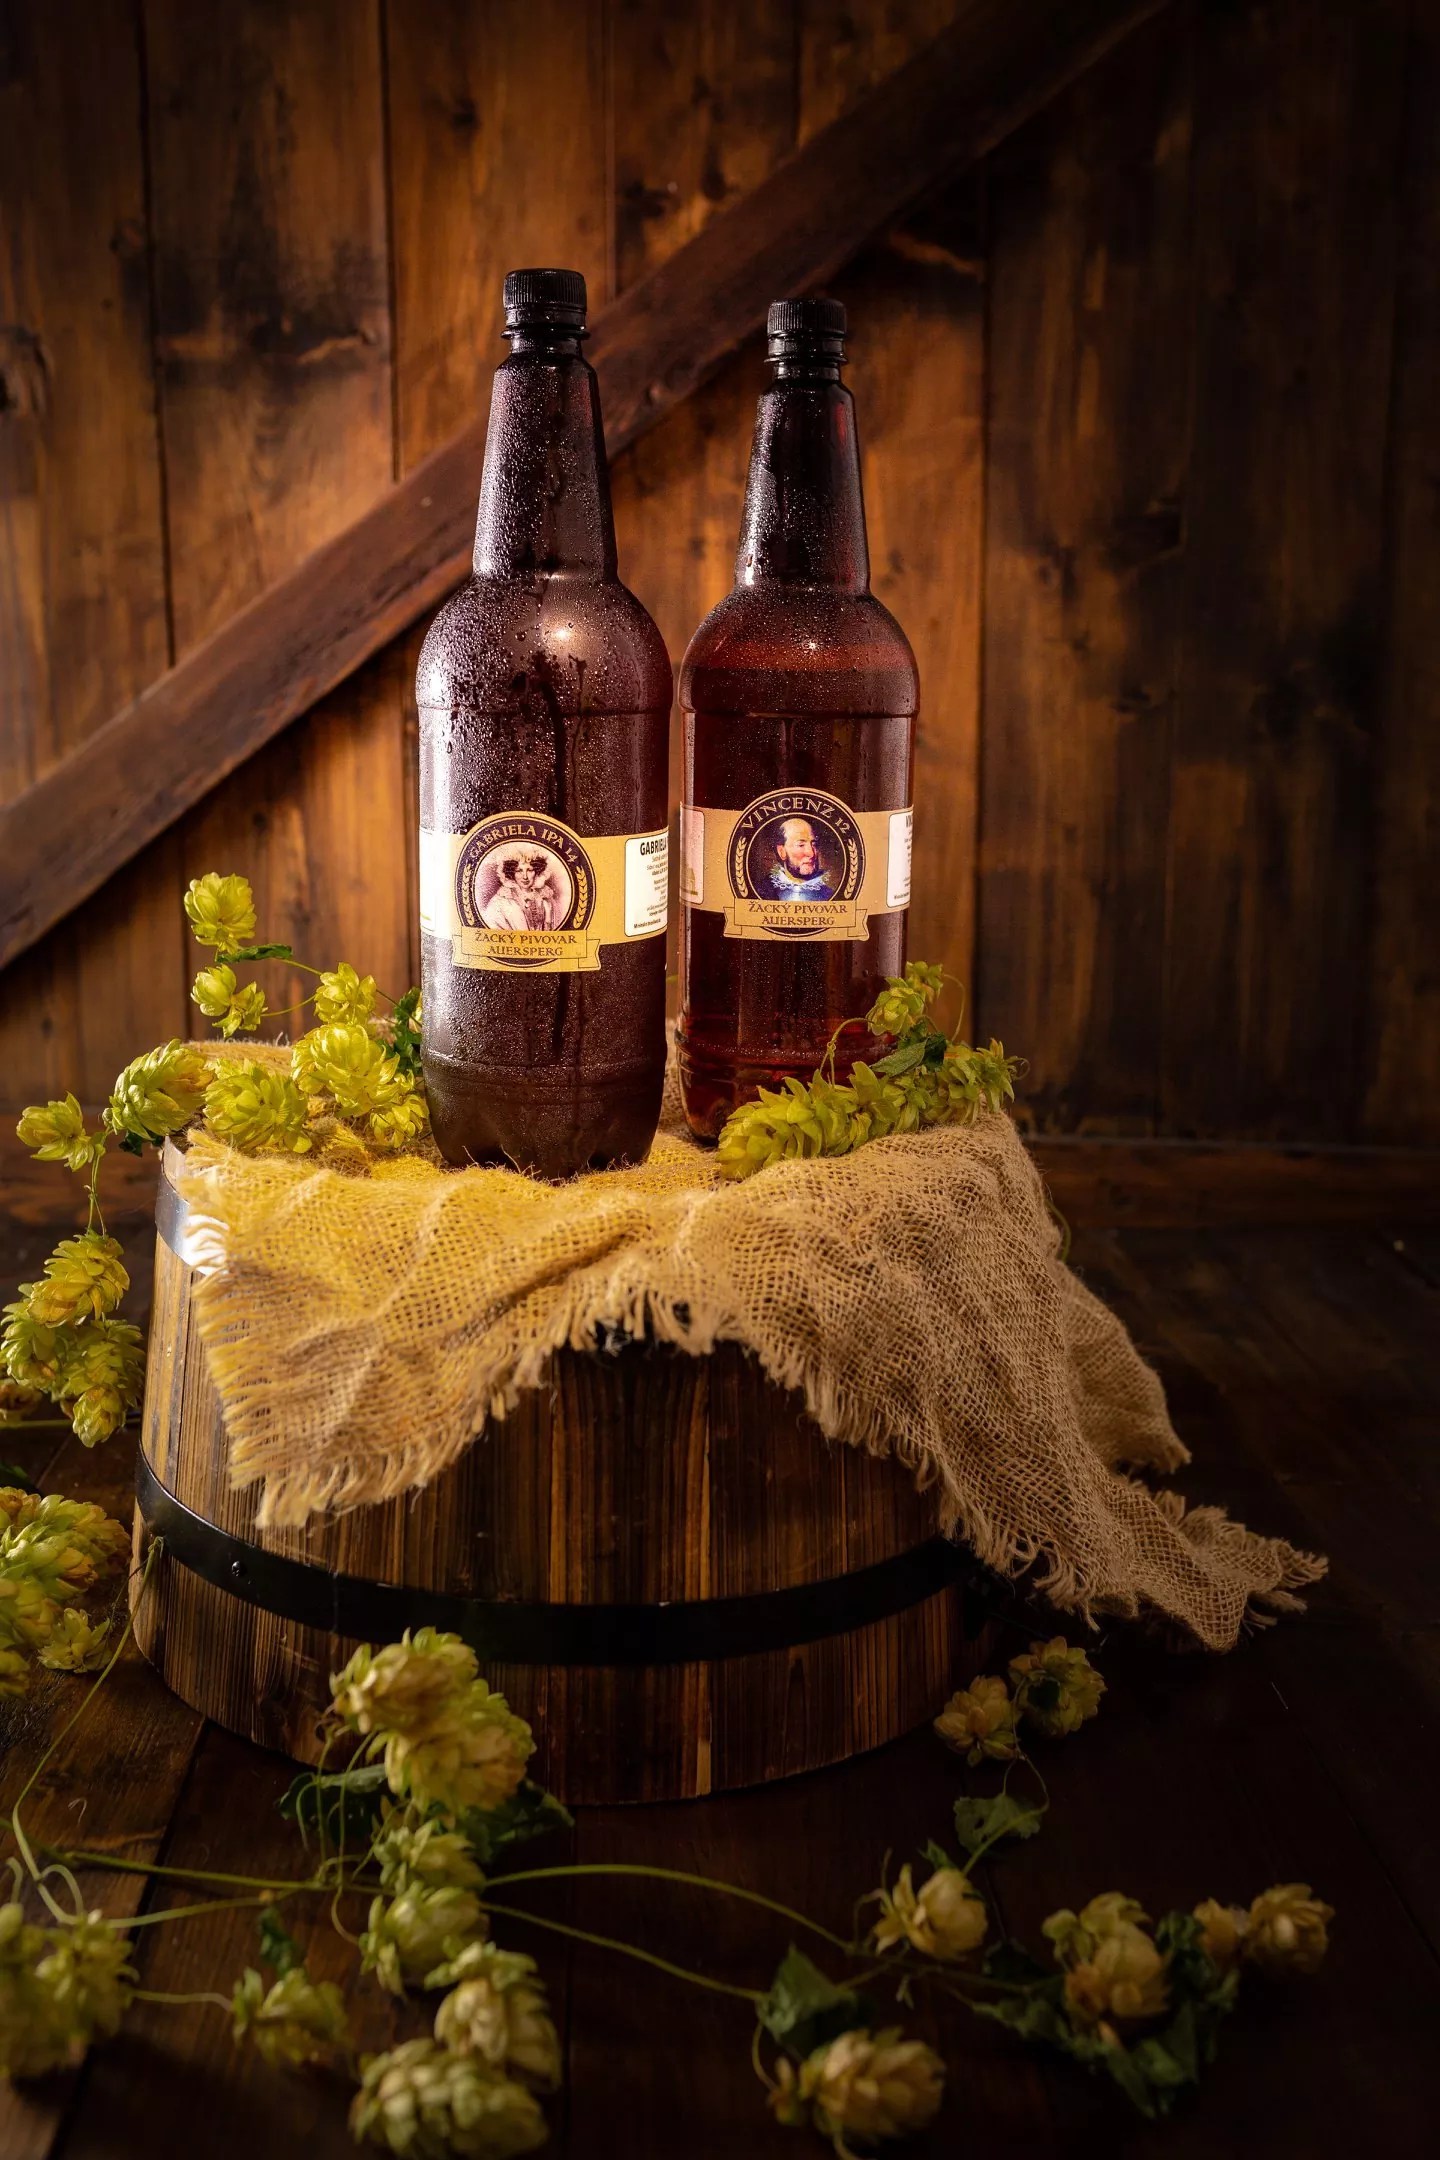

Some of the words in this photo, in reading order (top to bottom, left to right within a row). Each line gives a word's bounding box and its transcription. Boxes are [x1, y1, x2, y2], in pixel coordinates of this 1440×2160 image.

[742, 797, 836, 829] VINCENZ
[835, 817, 852, 834] 12
[469, 824, 537, 860] GABRIELA
[542, 828, 566, 848] IPA
[793, 903, 848, 914] PIVOVAR
[761, 915, 835, 926] AUERSPERG
[519, 934, 578, 945] PIVOVAR
[487, 945, 564, 957] AUERSPERG
